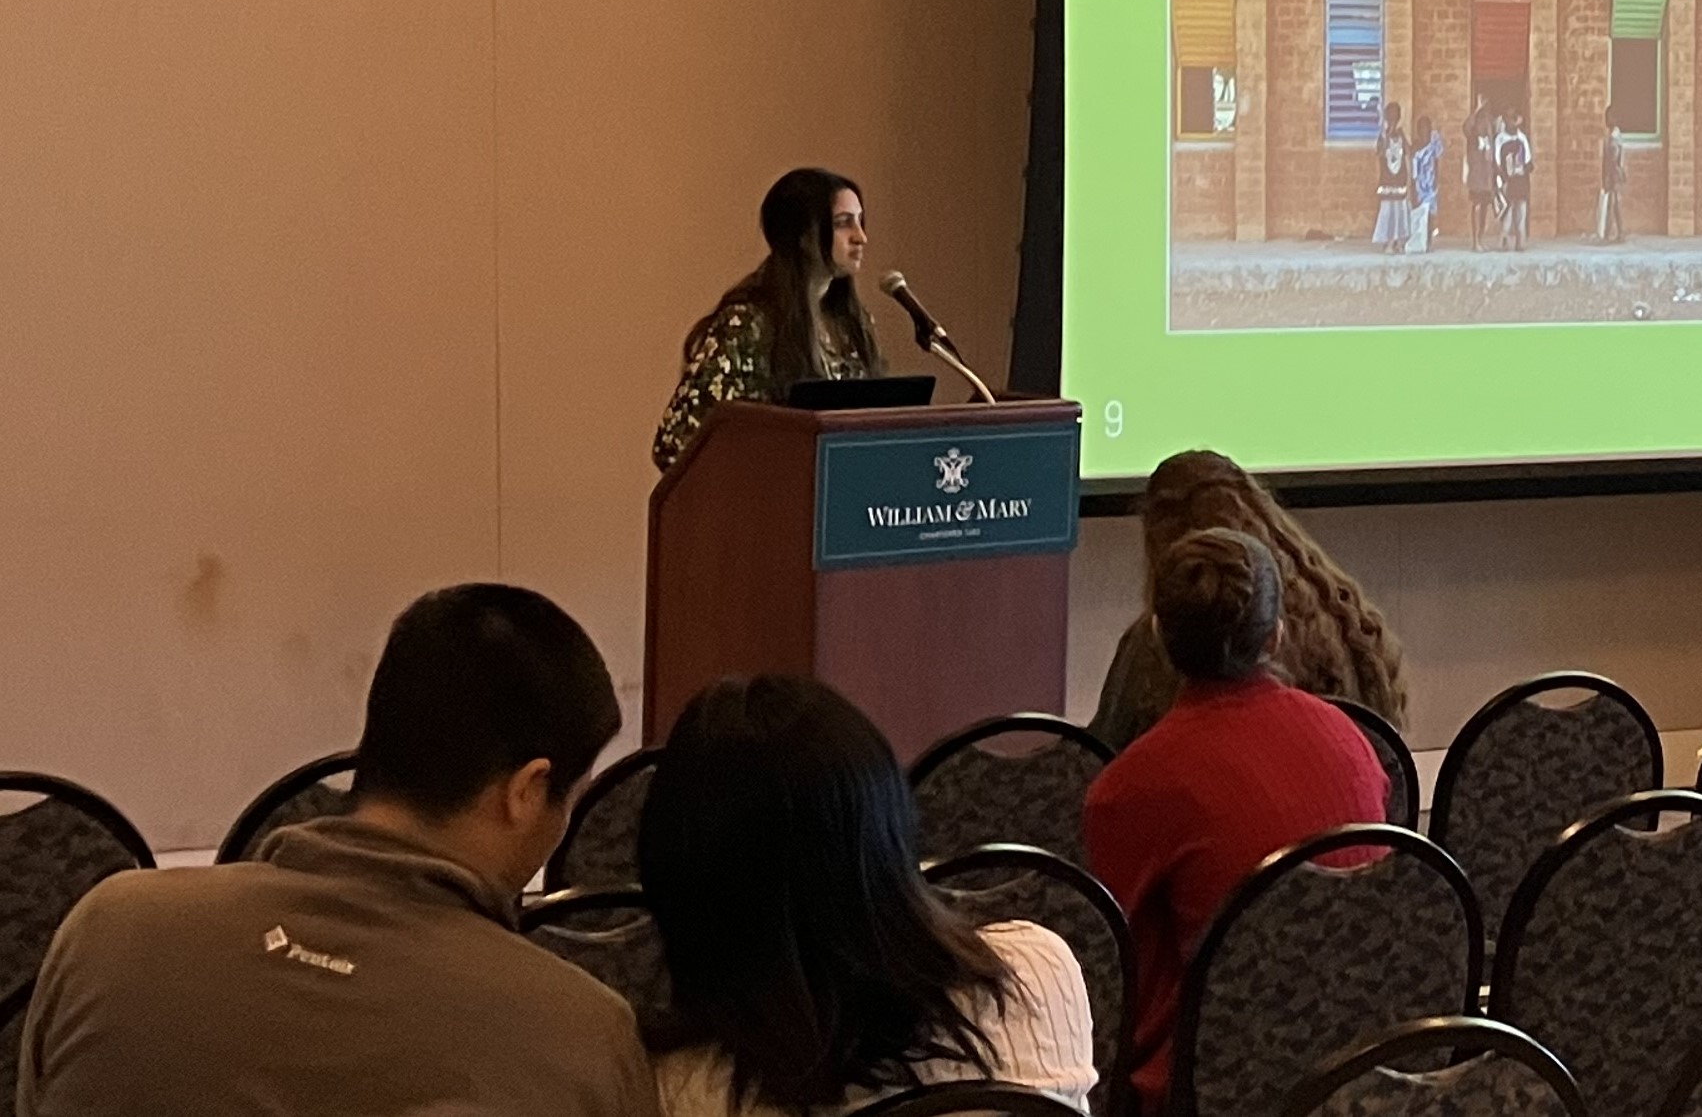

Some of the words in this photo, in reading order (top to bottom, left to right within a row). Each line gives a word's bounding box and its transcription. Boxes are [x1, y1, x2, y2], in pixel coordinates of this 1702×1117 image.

[1104, 399, 1124, 438] 9
[867, 503, 951, 527] WILLIAM
[955, 500, 975, 521] &
[976, 498, 1032, 520] MARY
